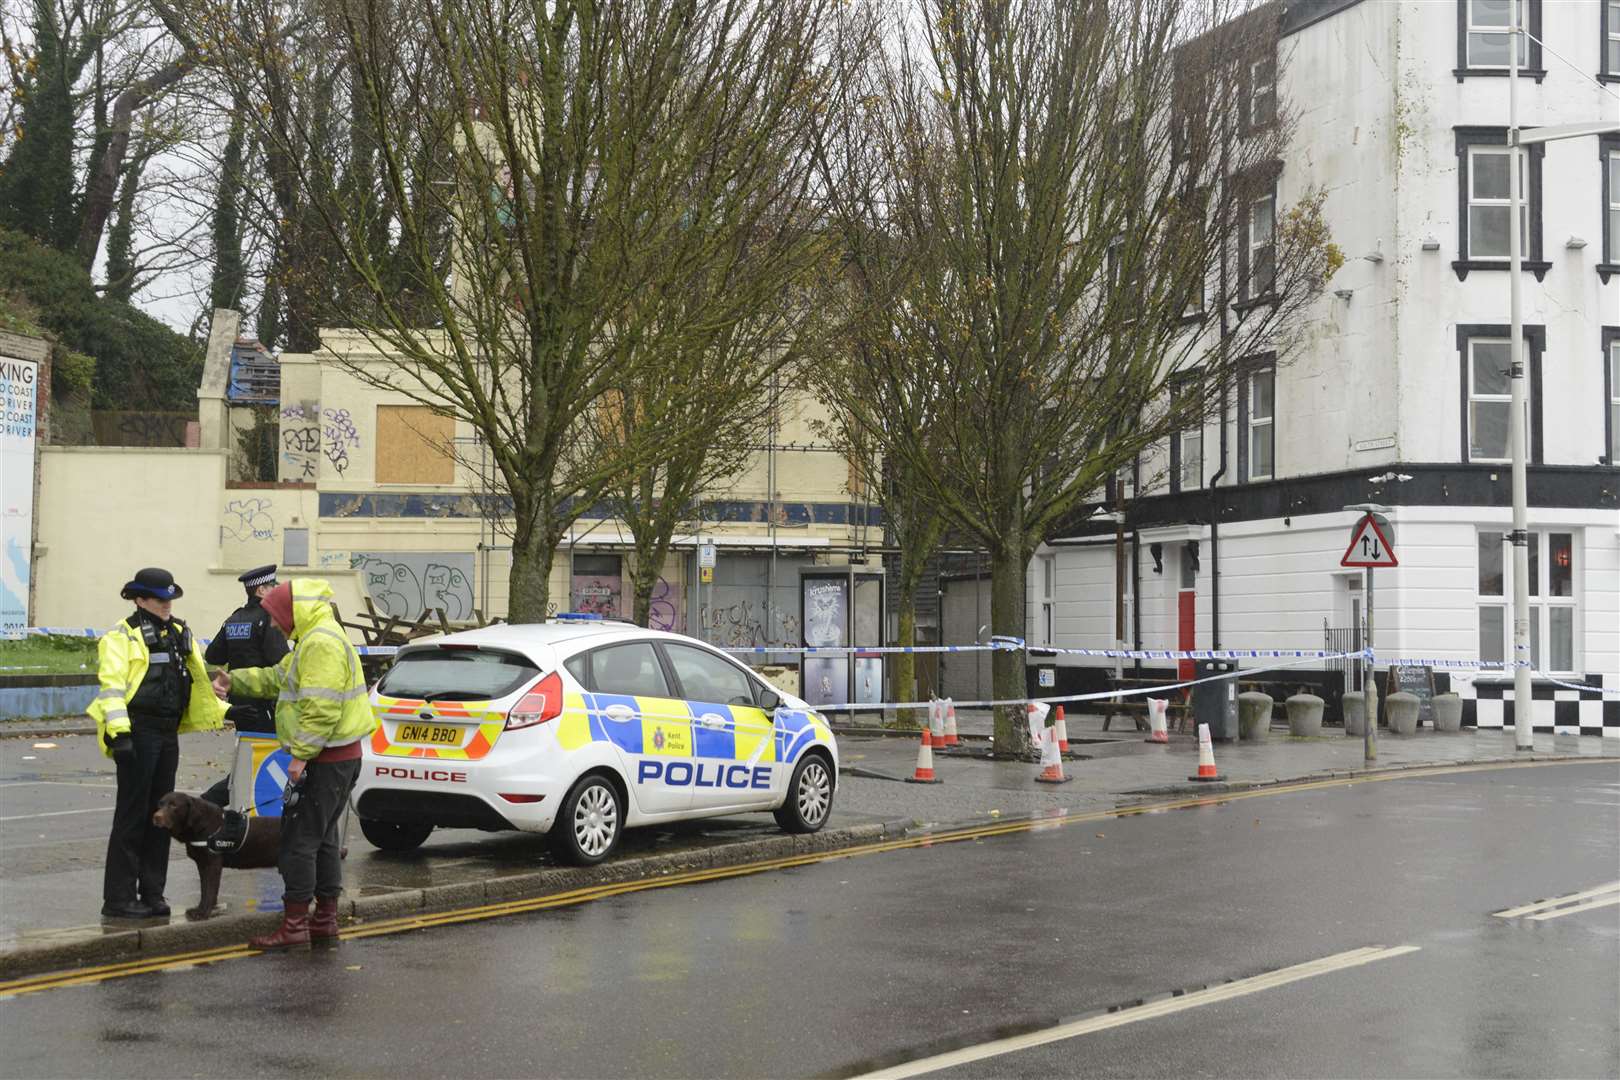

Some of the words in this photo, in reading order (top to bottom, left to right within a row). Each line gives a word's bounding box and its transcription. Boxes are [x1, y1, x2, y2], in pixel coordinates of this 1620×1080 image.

[8, 385, 33, 398] COAST
[7, 399, 33, 411] RIVER
[7, 411, 33, 424] COAST
[6, 425, 32, 438] RIVER
[226, 624, 249, 636] POLICE
[402, 726, 429, 741] GN14
[431, 727, 457, 743] BBO
[667, 742, 685, 750] Police
[375, 766, 468, 783] POLICE
[637, 760, 772, 789] POLICE
